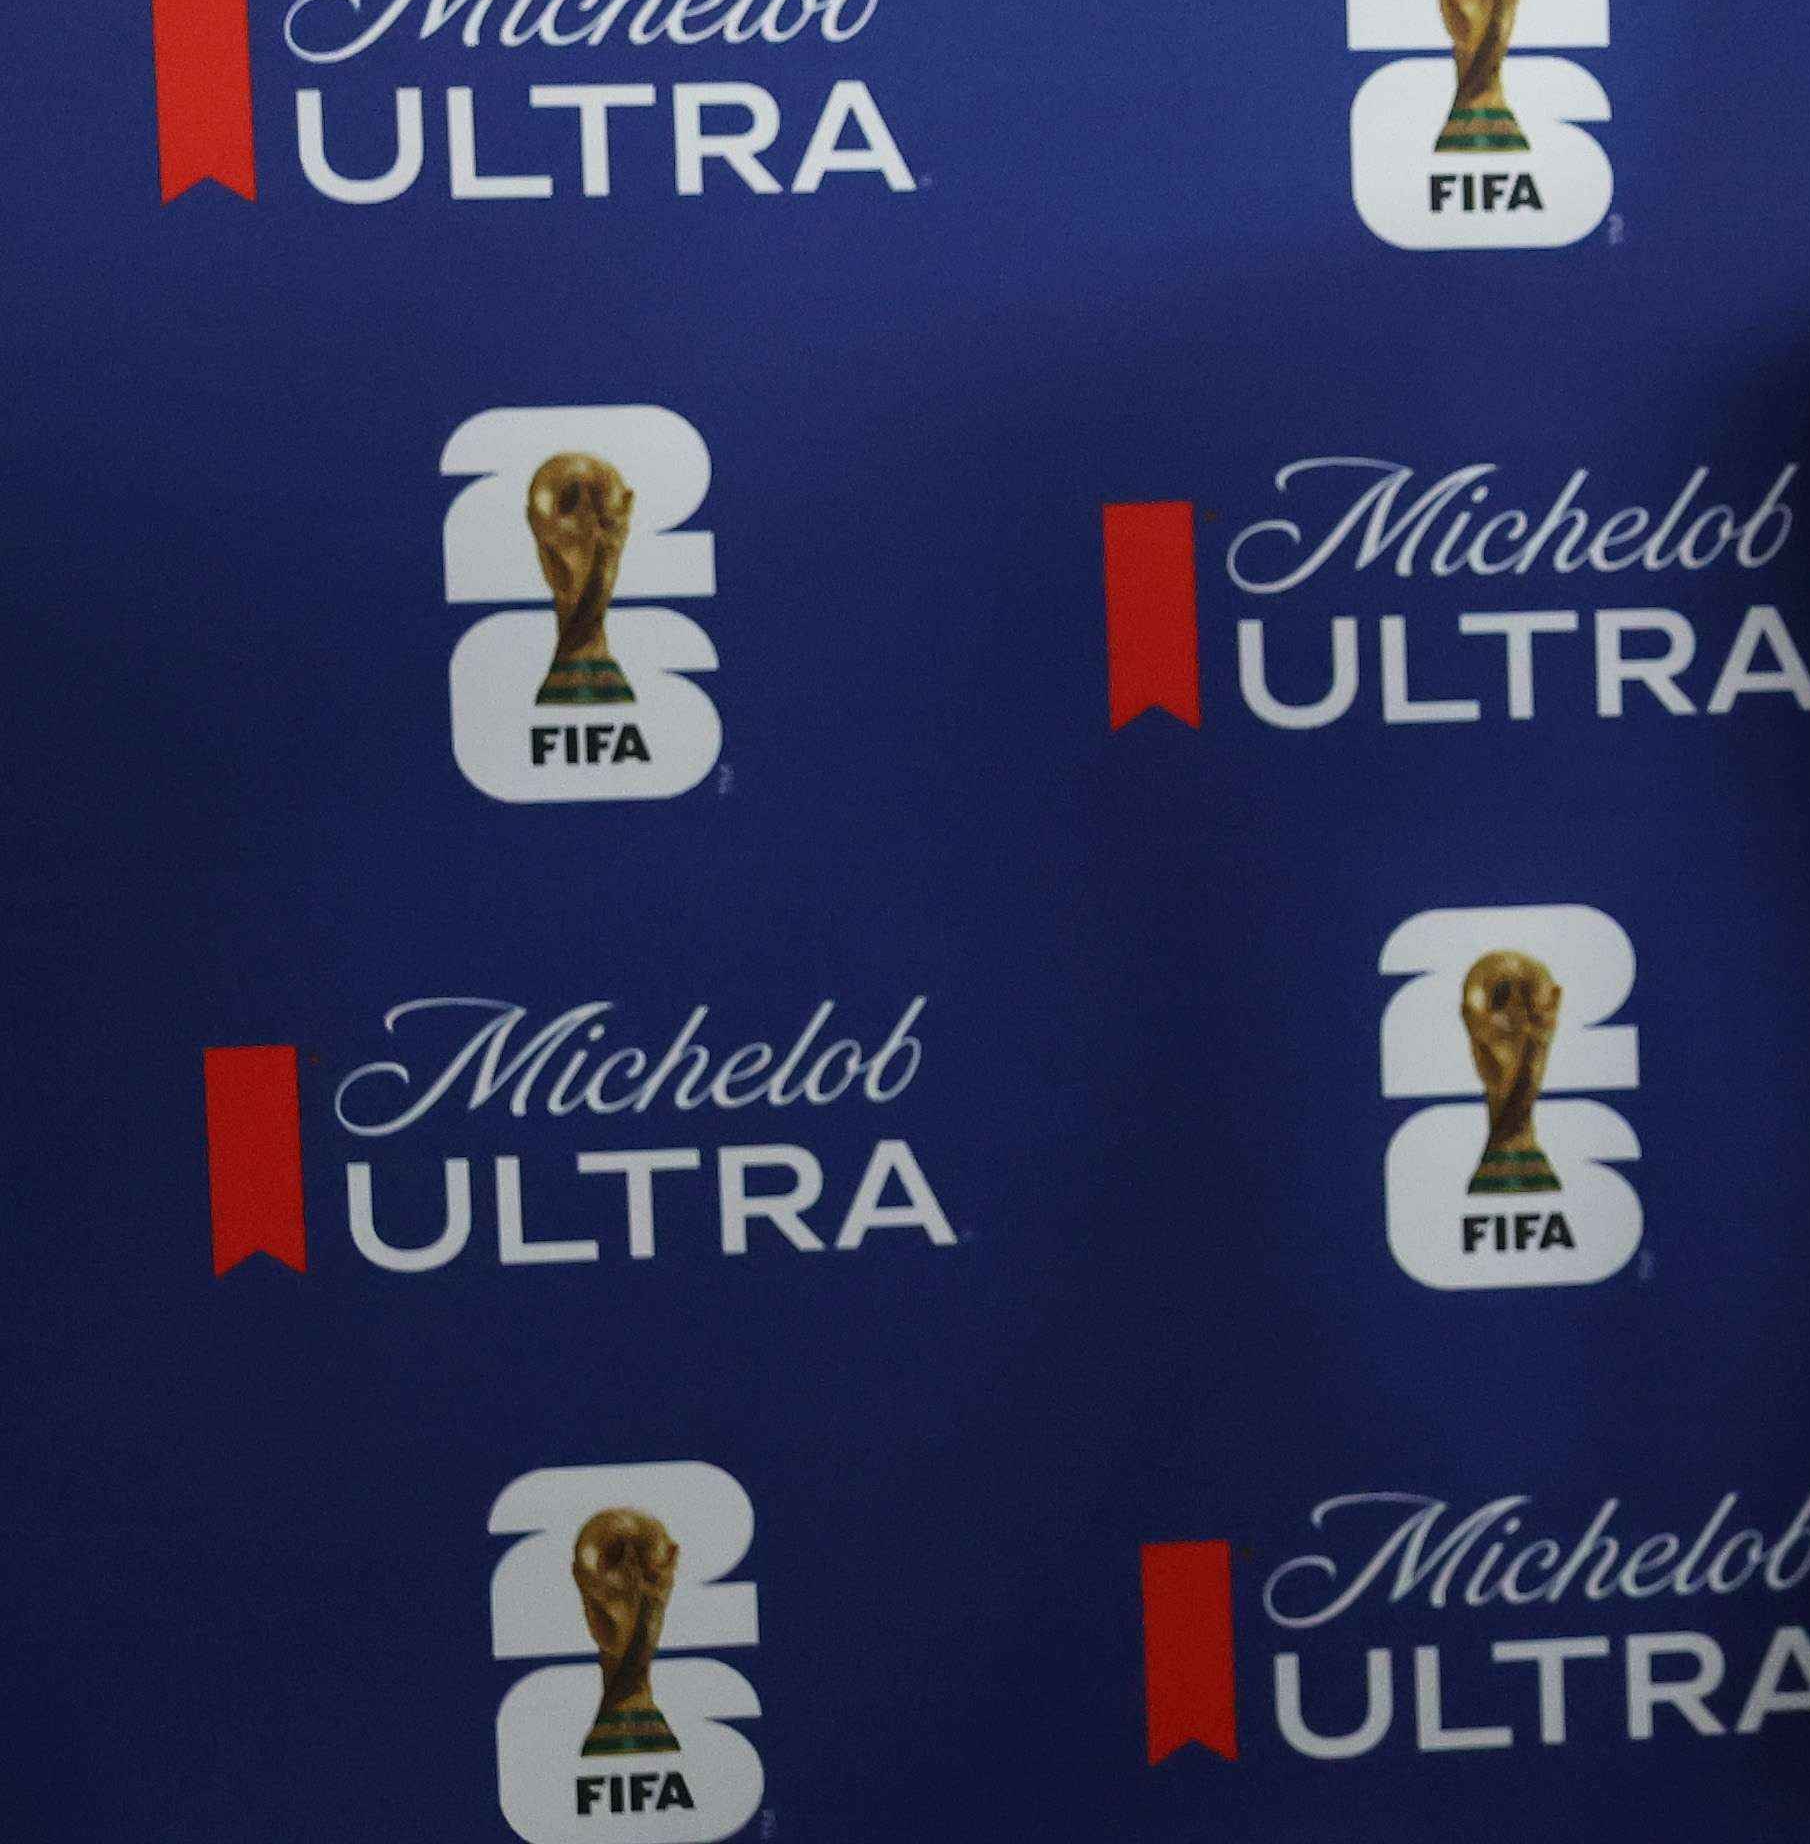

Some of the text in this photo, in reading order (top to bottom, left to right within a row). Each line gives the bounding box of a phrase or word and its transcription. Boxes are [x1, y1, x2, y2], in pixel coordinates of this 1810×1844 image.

[296, 80, 917, 204] ULTRA
[1429, 173, 1544, 213] FIFA
[1227, 457, 1795, 594] Michelob
[530, 723, 651, 766] FIFA
[335, 996, 926, 1136] Michelob
[346, 1139, 957, 1273] ULTRA
[1462, 1212, 1575, 1254] FIFA
[575, 1771, 695, 1816] FIFA
